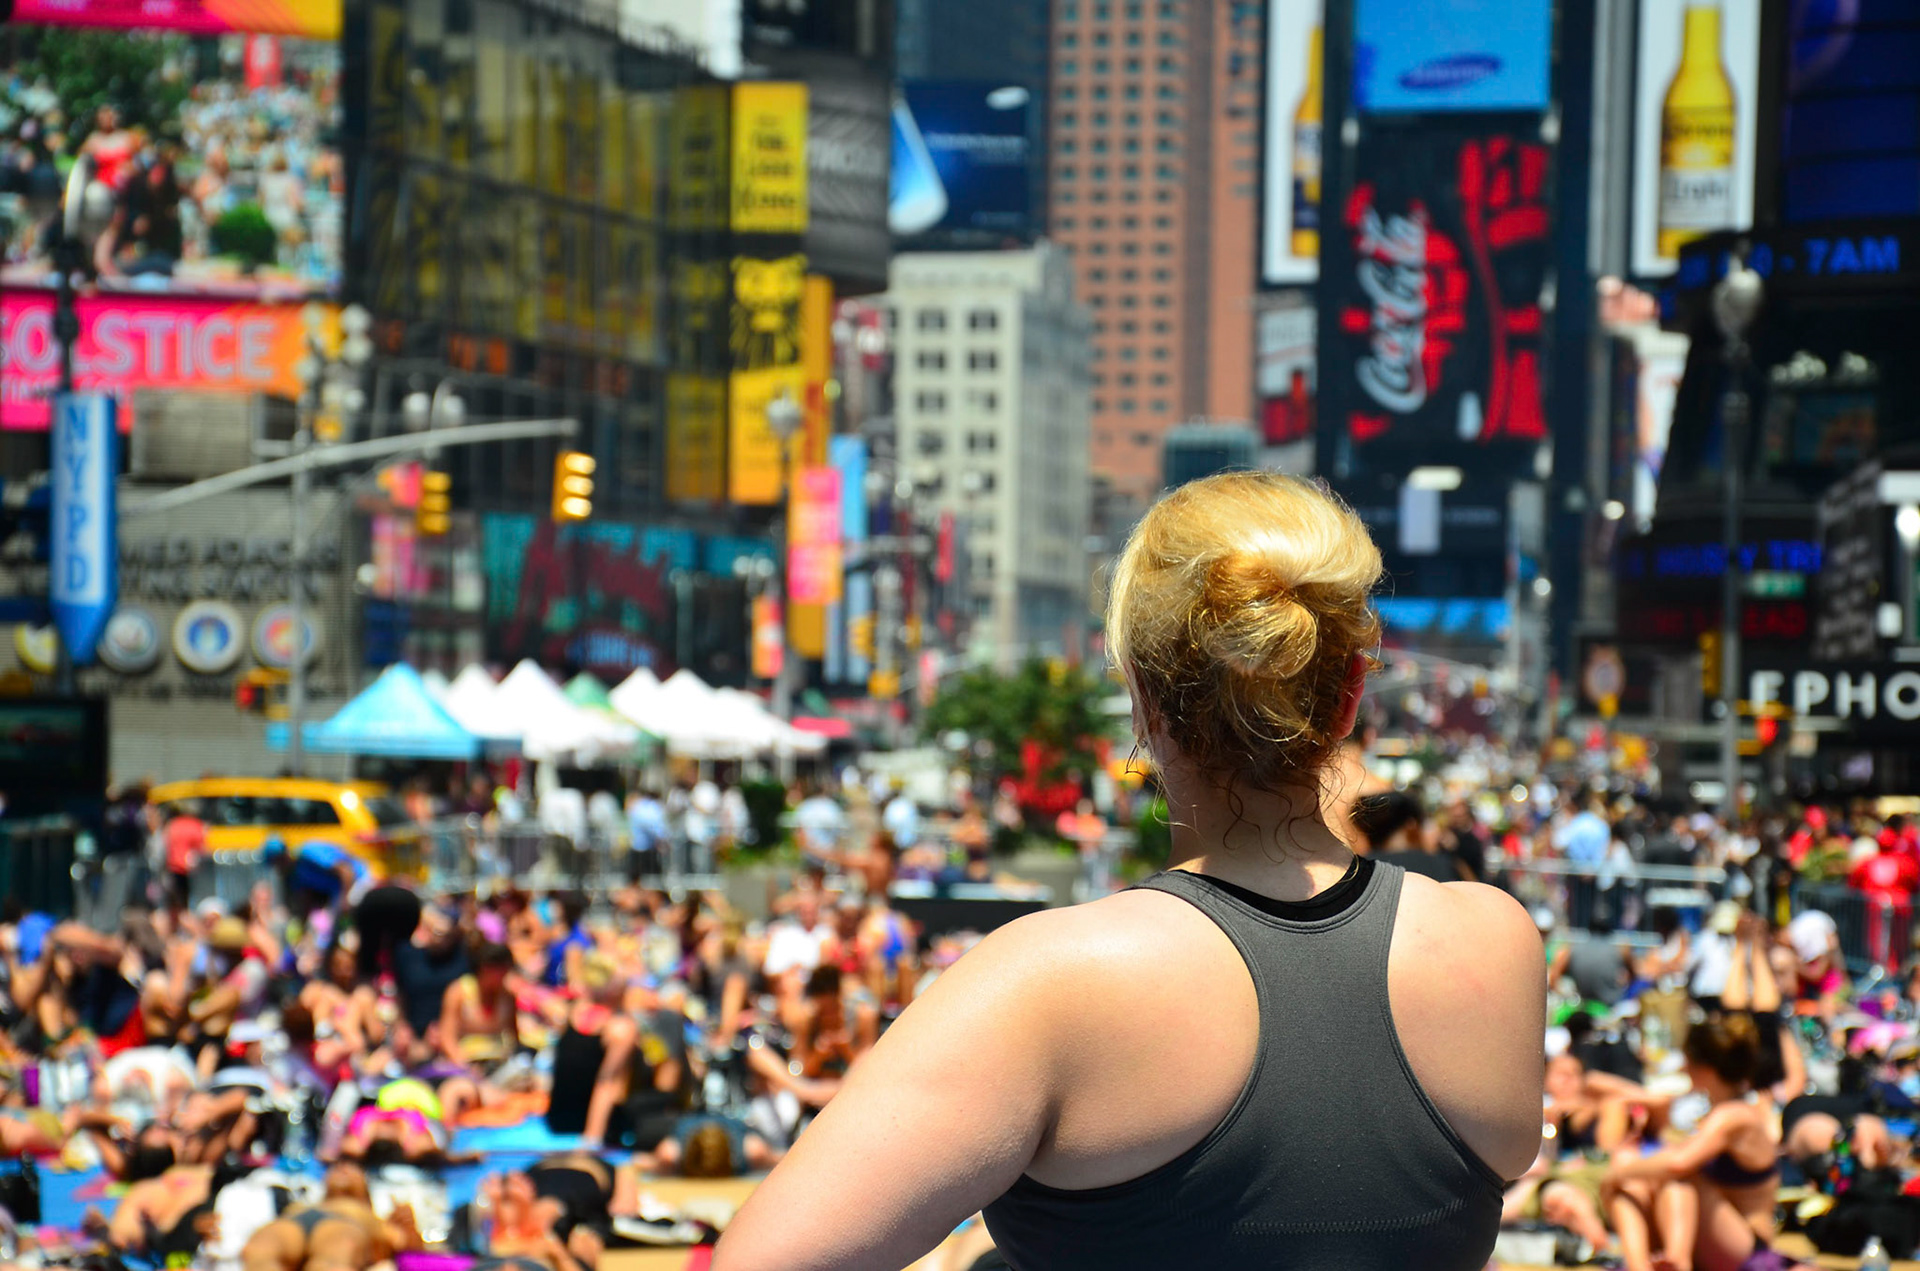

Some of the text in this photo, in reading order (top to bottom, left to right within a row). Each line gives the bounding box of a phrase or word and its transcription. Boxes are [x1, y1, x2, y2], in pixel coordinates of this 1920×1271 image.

[1804, 235, 1899, 276] 7AM
[0, 309, 275, 379] OLSTICE
[64, 400, 88, 591] NYPD
